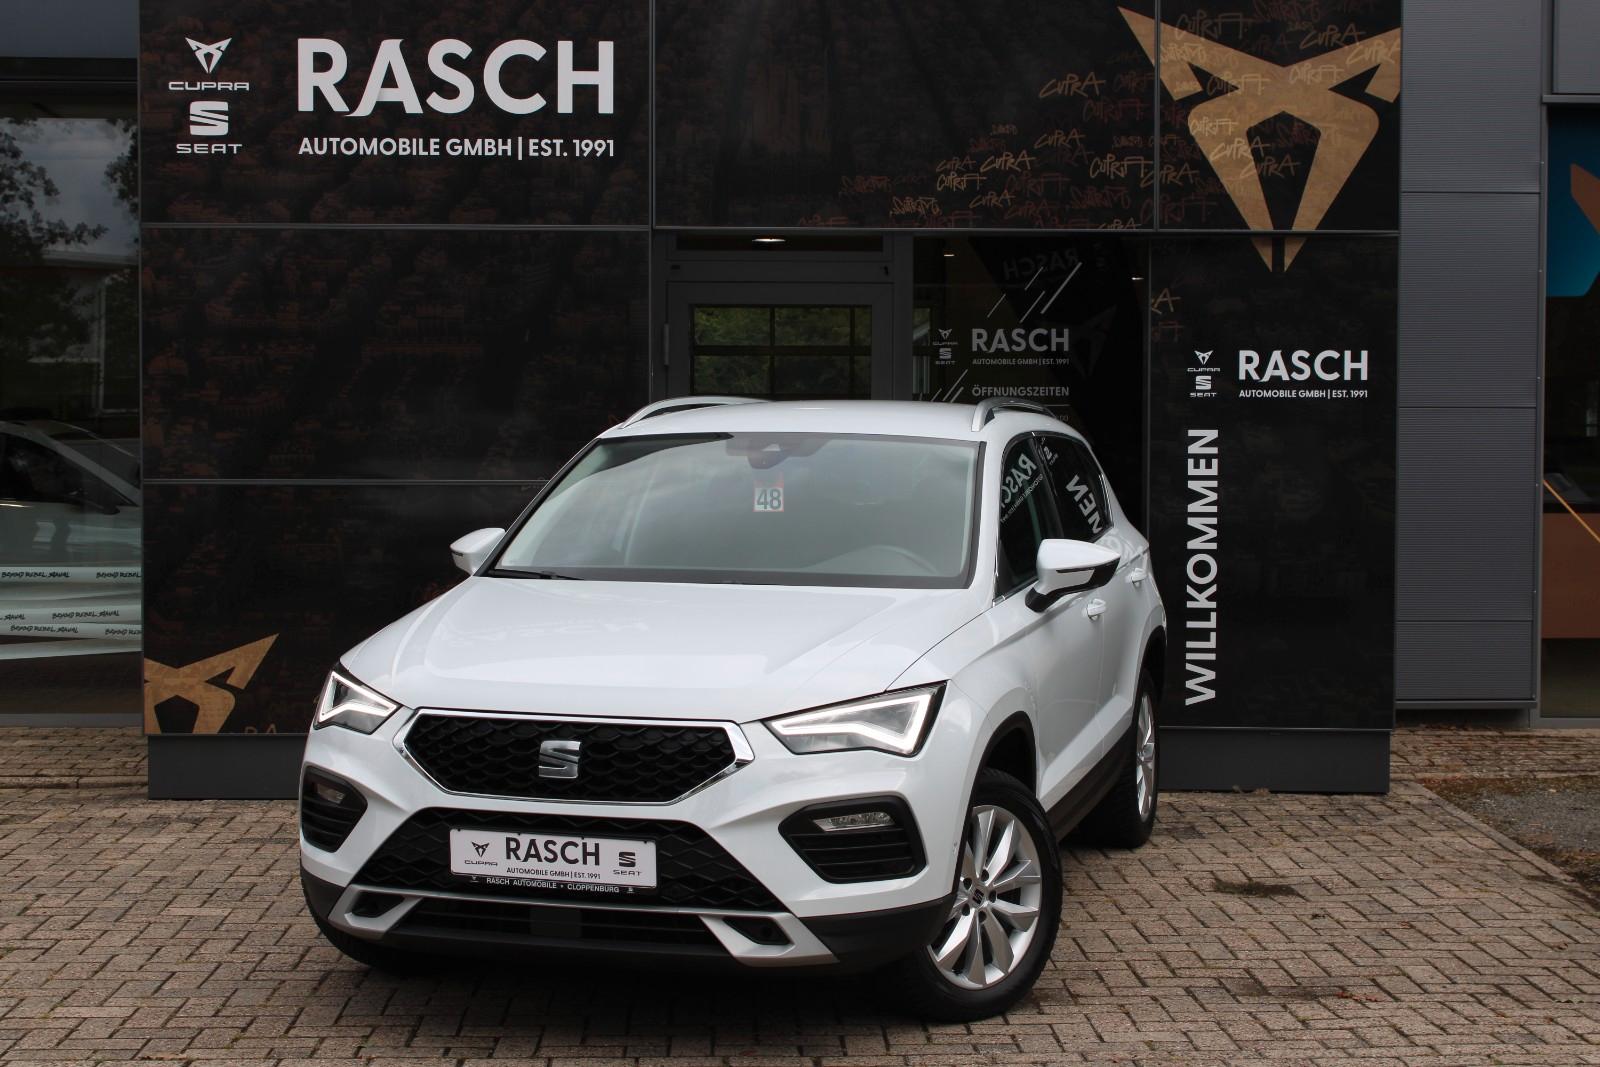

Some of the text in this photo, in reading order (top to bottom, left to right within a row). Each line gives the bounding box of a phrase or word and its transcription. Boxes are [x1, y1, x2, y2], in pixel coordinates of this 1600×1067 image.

[168, 81, 250, 92] CUPRA
[297, 38, 614, 117] RASCH
[1039, 71, 1106, 98] CUPRA
[298, 137, 614, 157] AUTOMOBILE GMBH EST. 1991
[1034, 127, 1086, 149] CUPRA
[176, 143, 242, 155] SEAT
[980, 150, 1036, 172] CUPRA
[972, 328, 1070, 354] RASCH
[972, 358, 1016, 366] AUTOMOBILE
[1056, 358, 1070, 366] 1991
[1238, 350, 1369, 383] RASCH
[972, 384, 1070, 397] ÖFFNUNGSZEITEN
[1238, 390, 1297, 399] AUTOMOBILE
[1332, 390, 1349, 399] EST.
[1350, 390, 1368, 399] 1991
[756, 488, 782, 510] 48
[1185, 429, 1219, 706] WILLKOMMEN
[505, 836, 600, 866] RASCH
[464, 859, 498, 867] CUPRA
[506, 867, 549, 877] AUTOMOBILE
[612, 869, 643, 877] SEAT
[486, 877, 620, 893] RASCH AUTOMOBILE CLOPPENBURG
